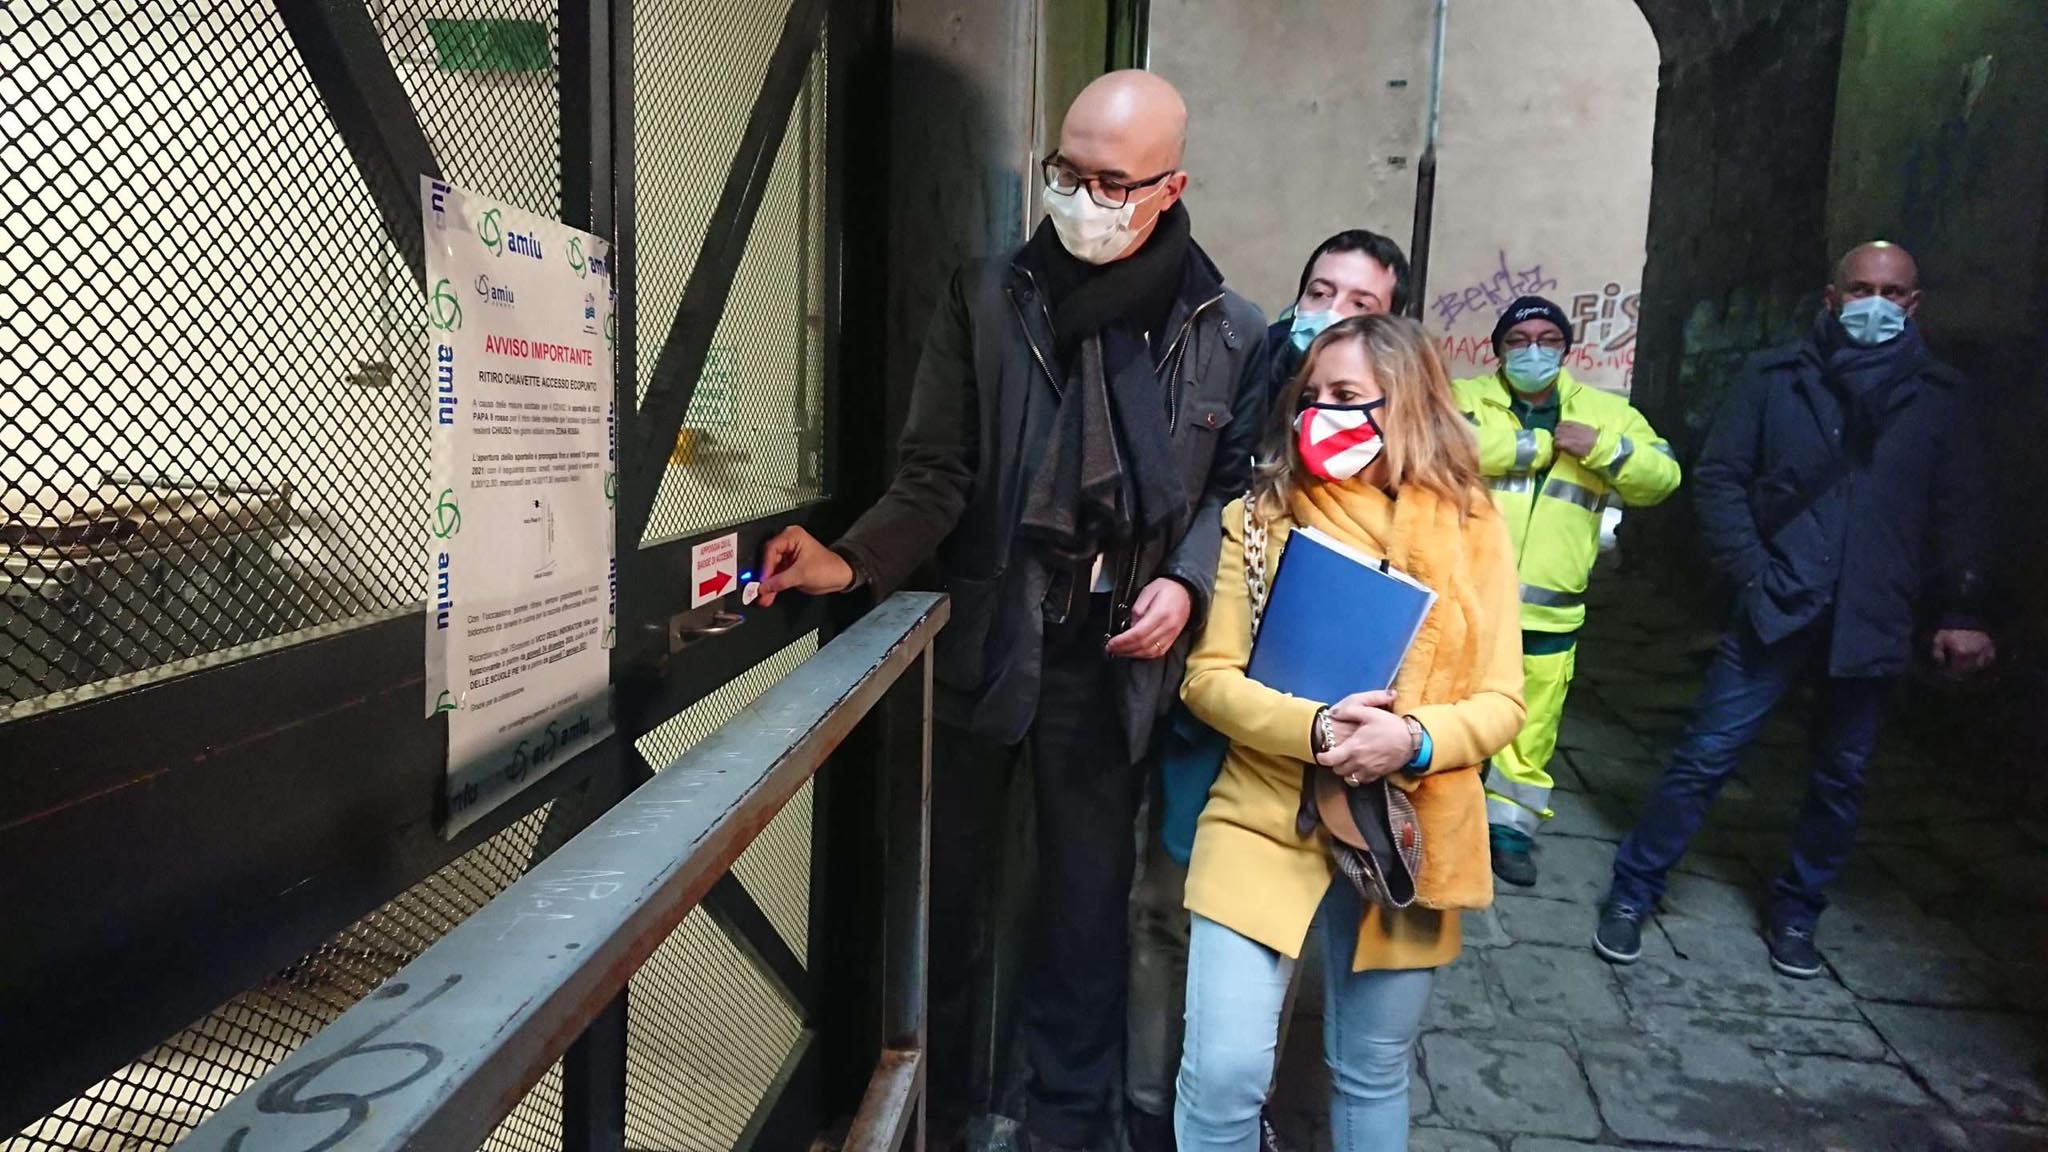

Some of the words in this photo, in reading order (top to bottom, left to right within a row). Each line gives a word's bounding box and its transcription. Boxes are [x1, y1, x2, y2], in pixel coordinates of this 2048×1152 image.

[508, 231, 543, 260] amiu
[491, 282, 514, 304] amiu
[485, 334, 529, 358] AVVISO
[531, 341, 593, 366] IMPORTANTE
[438, 343, 458, 425] amiu
[479, 371, 503, 384] RITIRO
[504, 373, 541, 387] CHIAVETTE
[542, 377, 570, 390] ACCESSO
[570, 379, 598, 392] ECOPUNTO
[437, 552, 453, 630] amiu
